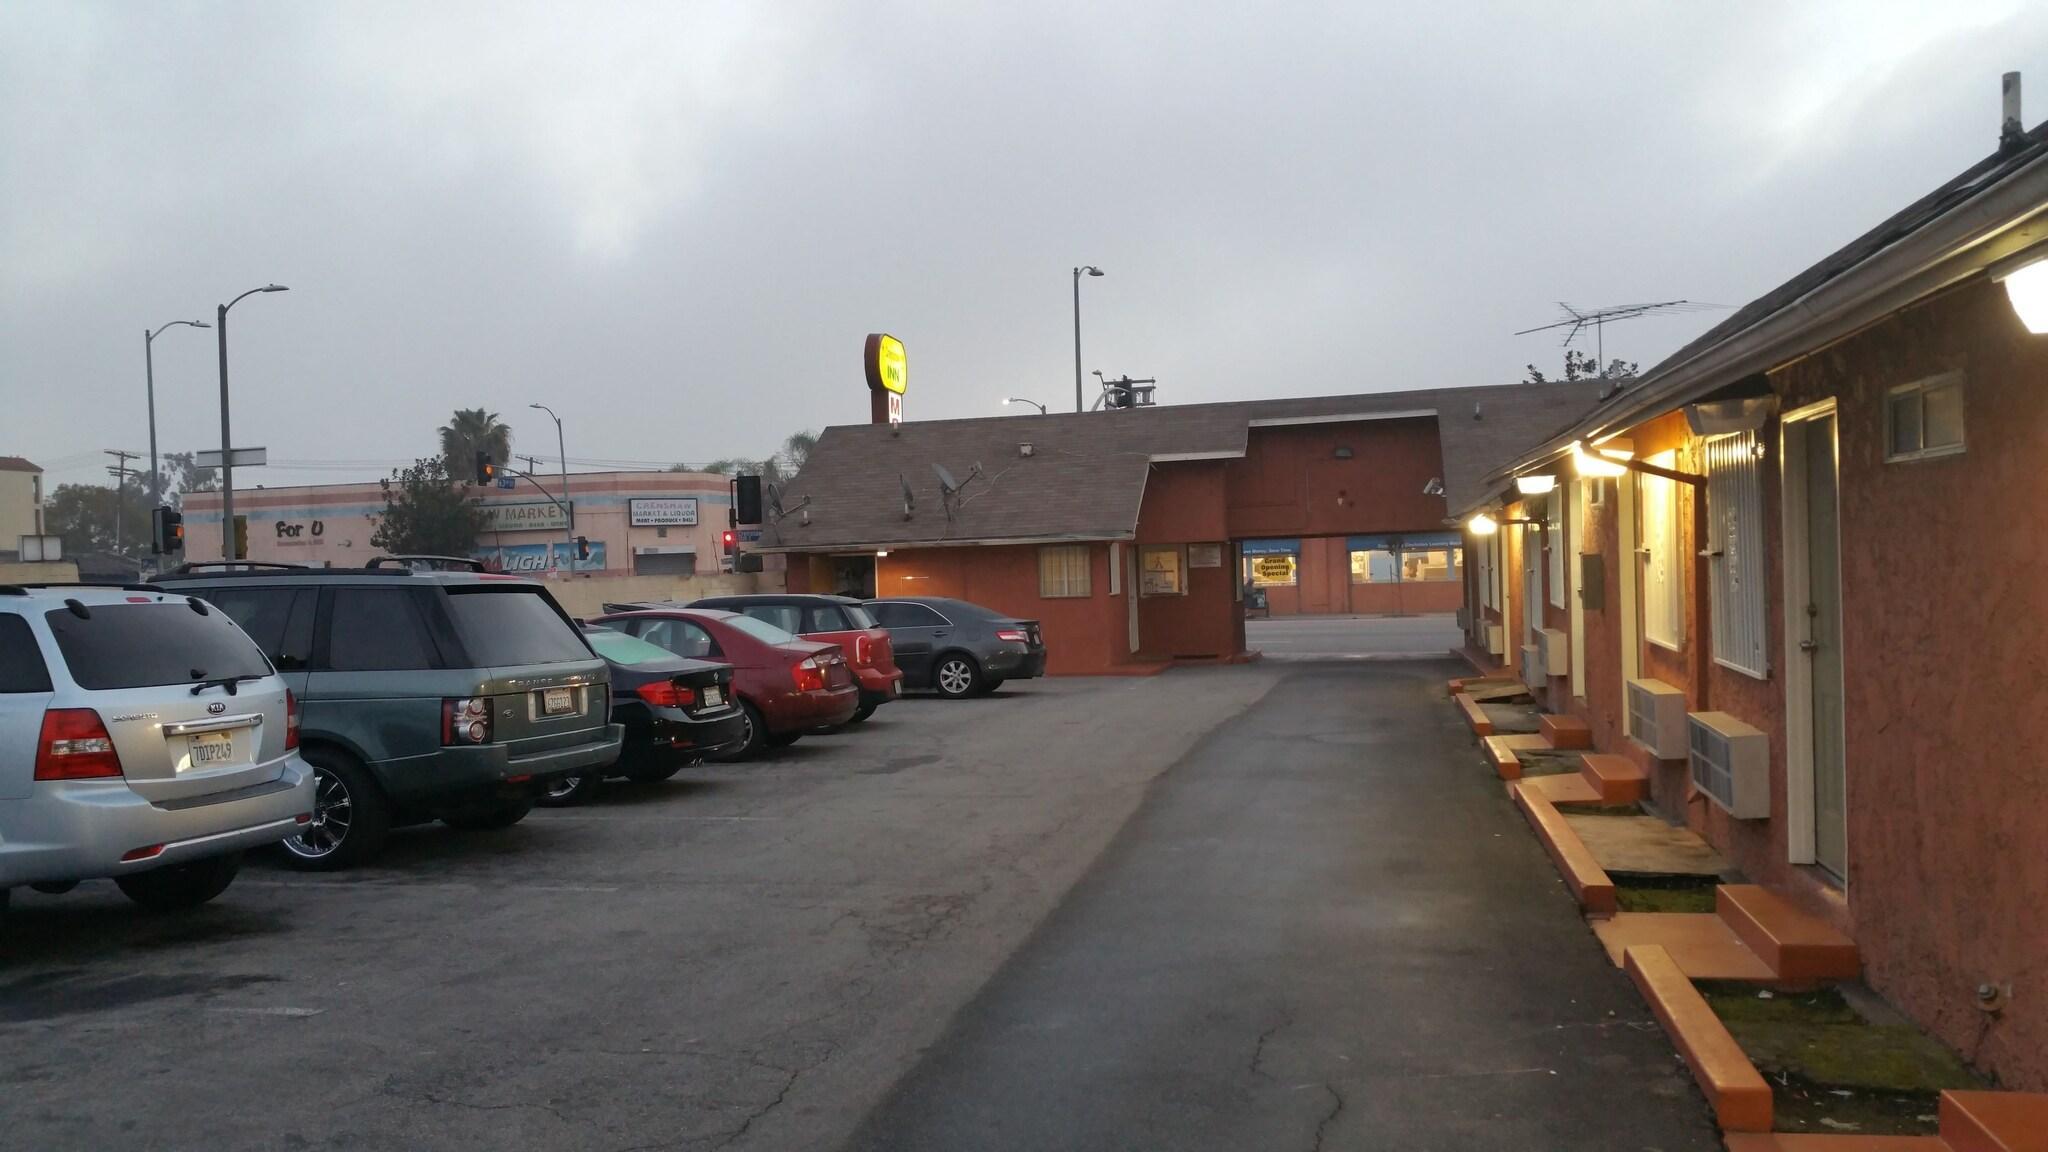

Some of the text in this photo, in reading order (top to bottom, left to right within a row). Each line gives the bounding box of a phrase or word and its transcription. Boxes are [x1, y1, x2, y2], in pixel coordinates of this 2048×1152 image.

[887, 365, 899, 382] INN
[210, 703, 225, 713] KIA
[193, 743, 232, 761] 7DIP249
